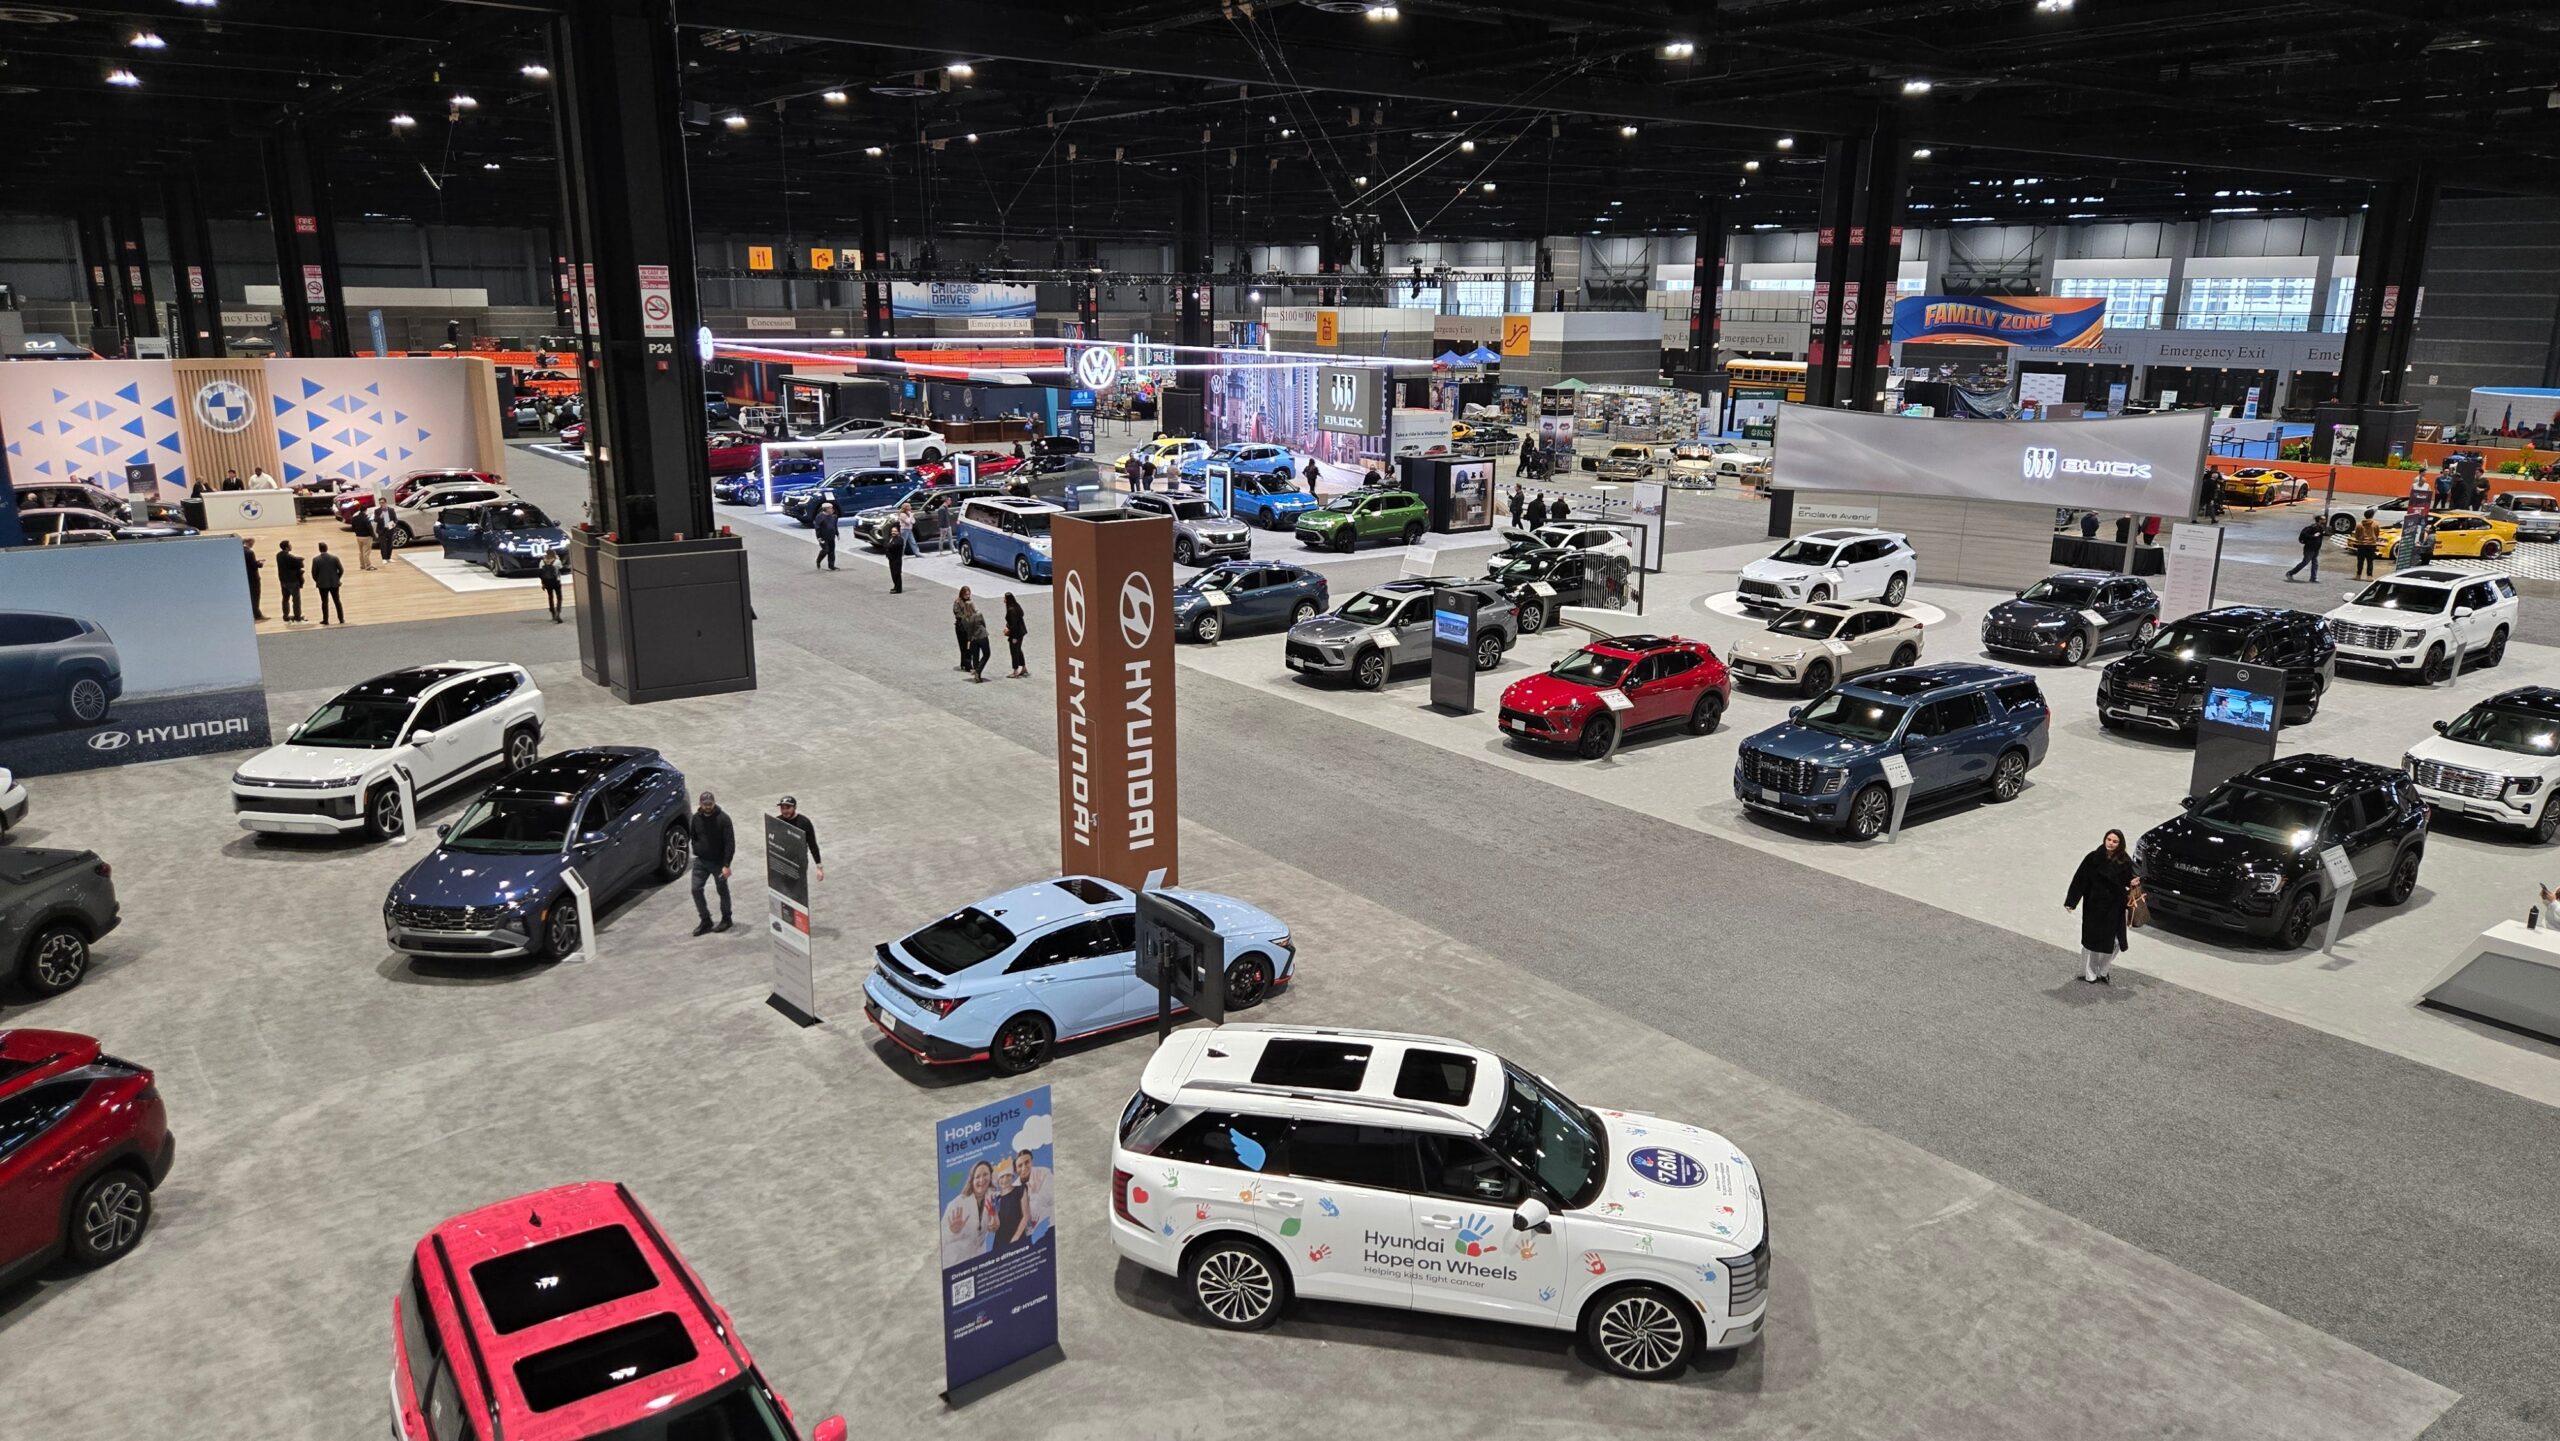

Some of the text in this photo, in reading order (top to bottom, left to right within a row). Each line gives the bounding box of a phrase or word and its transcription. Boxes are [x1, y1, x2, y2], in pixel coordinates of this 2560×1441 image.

[932, 294, 970, 305] DRIVES
[751, 319, 792, 327] Concession
[972, 319, 1028, 328] Emergency Exit
[1924, 302, 2053, 331] FAMILY ZONE
[648, 343, 672, 354] P24
[1767, 333, 1785, 345] Exit
[2160, 344, 2266, 361] Emergency Exit
[1323, 415, 1364, 428] BUICK
[2060, 458, 2152, 479] BUICK
[1798, 510, 1871, 521] Enclave Avenir
[137, 717, 249, 744] HYUNDAI
[1068, 657, 1090, 847] HYUNDAI
[1125, 659, 1154, 851] HYUNDAI
[945, 1108, 1020, 1142] Hope lights
[945, 1128, 1000, 1154] the way
[1657, 1149, 1678, 1183] $7.6M
[1364, 1229, 1444, 1253] Hyundai
[951, 1267, 971, 1280] Driven
[979, 1259, 995, 1269] make
[1000, 1245, 1030, 1261] difference
[1364, 1249, 1518, 1281] Hope on Wheels
[1364, 1265, 1486, 1289] Helping kids fight cancer
[1022, 1294, 1048, 1309] HYUNDAI
